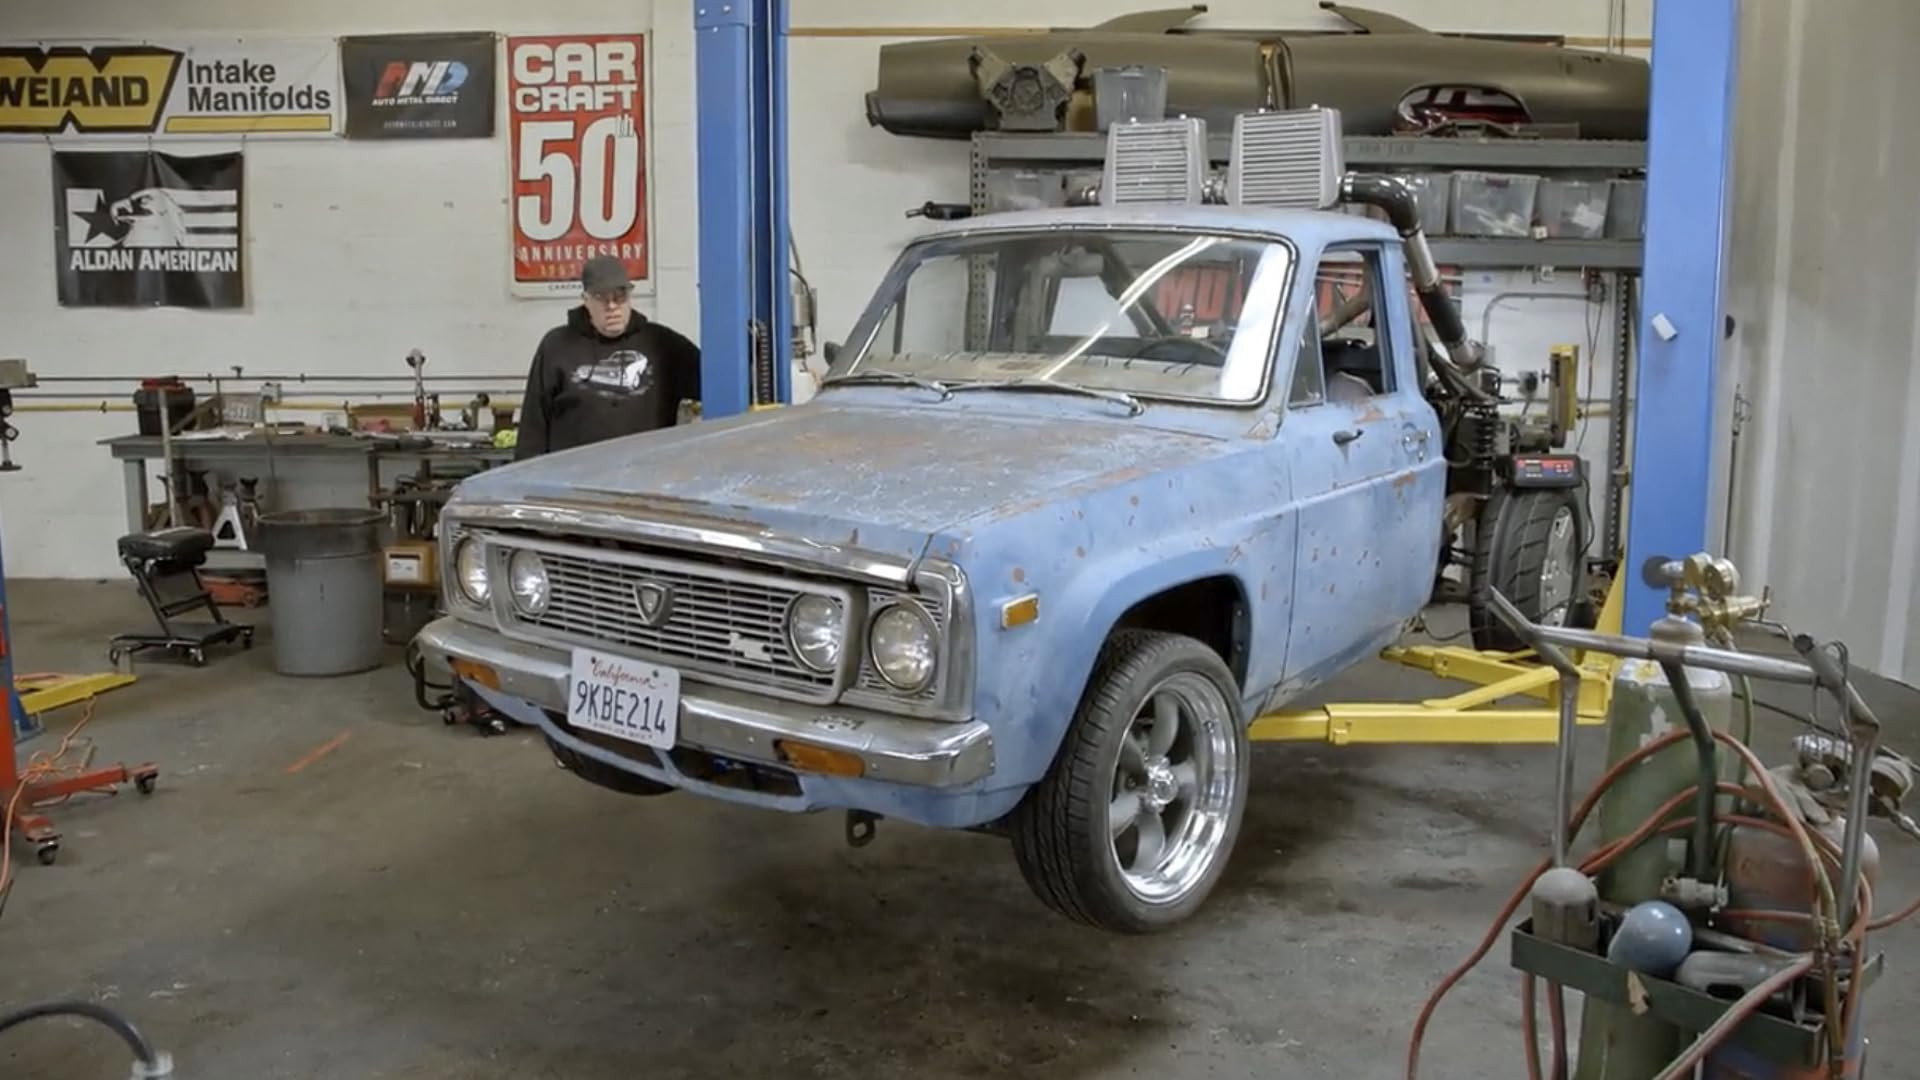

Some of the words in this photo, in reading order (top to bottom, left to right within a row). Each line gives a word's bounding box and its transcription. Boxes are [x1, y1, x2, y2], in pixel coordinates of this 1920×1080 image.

[187, 59, 276, 84] Intake
[513, 41, 637, 85] CAR
[0, 76, 149, 107] WEIAND
[188, 85, 331, 112] Manifolds
[515, 84, 638, 113] CRAFT
[70, 249, 134, 271] ALDAN
[138, 250, 238, 272] AMERICAN
[519, 243, 643, 262] ANNIVERSARY
[592, 660, 657, 690] California
[575, 680, 667, 734] 9KBE214
